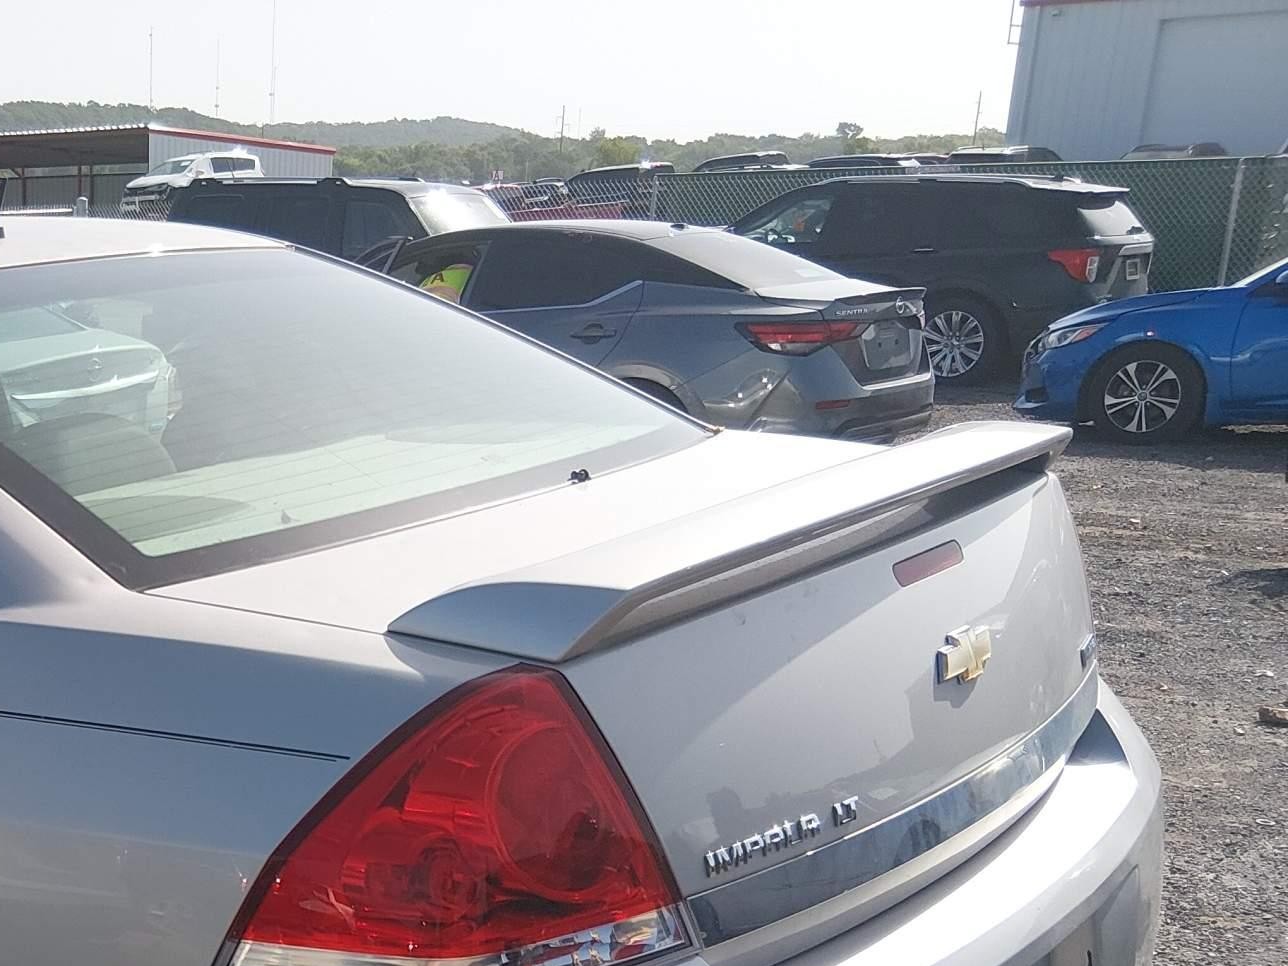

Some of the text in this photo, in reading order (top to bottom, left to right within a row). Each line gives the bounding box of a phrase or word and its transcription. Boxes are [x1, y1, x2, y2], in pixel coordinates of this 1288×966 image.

[835, 307, 867, 316] SENTRA
[704, 795, 859, 878] IMPALA LT
